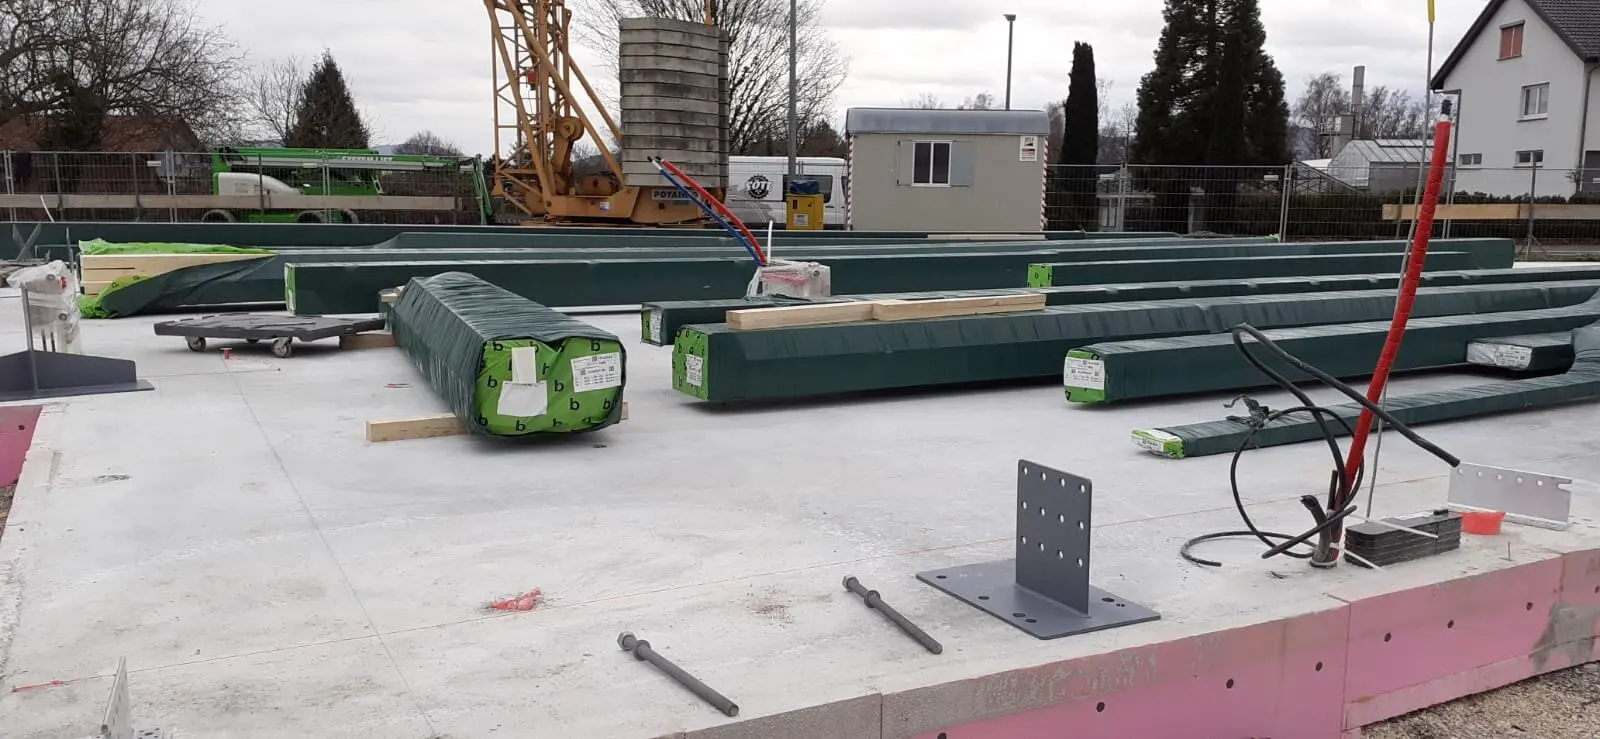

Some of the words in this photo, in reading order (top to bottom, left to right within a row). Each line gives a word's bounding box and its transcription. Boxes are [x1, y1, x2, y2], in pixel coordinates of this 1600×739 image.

[492, 341, 504, 352] b
[590, 341, 601, 352] b
[487, 374, 498, 389] b
[554, 379, 565, 392] b
[569, 397, 580, 411] b
[515, 419, 526, 432] b
